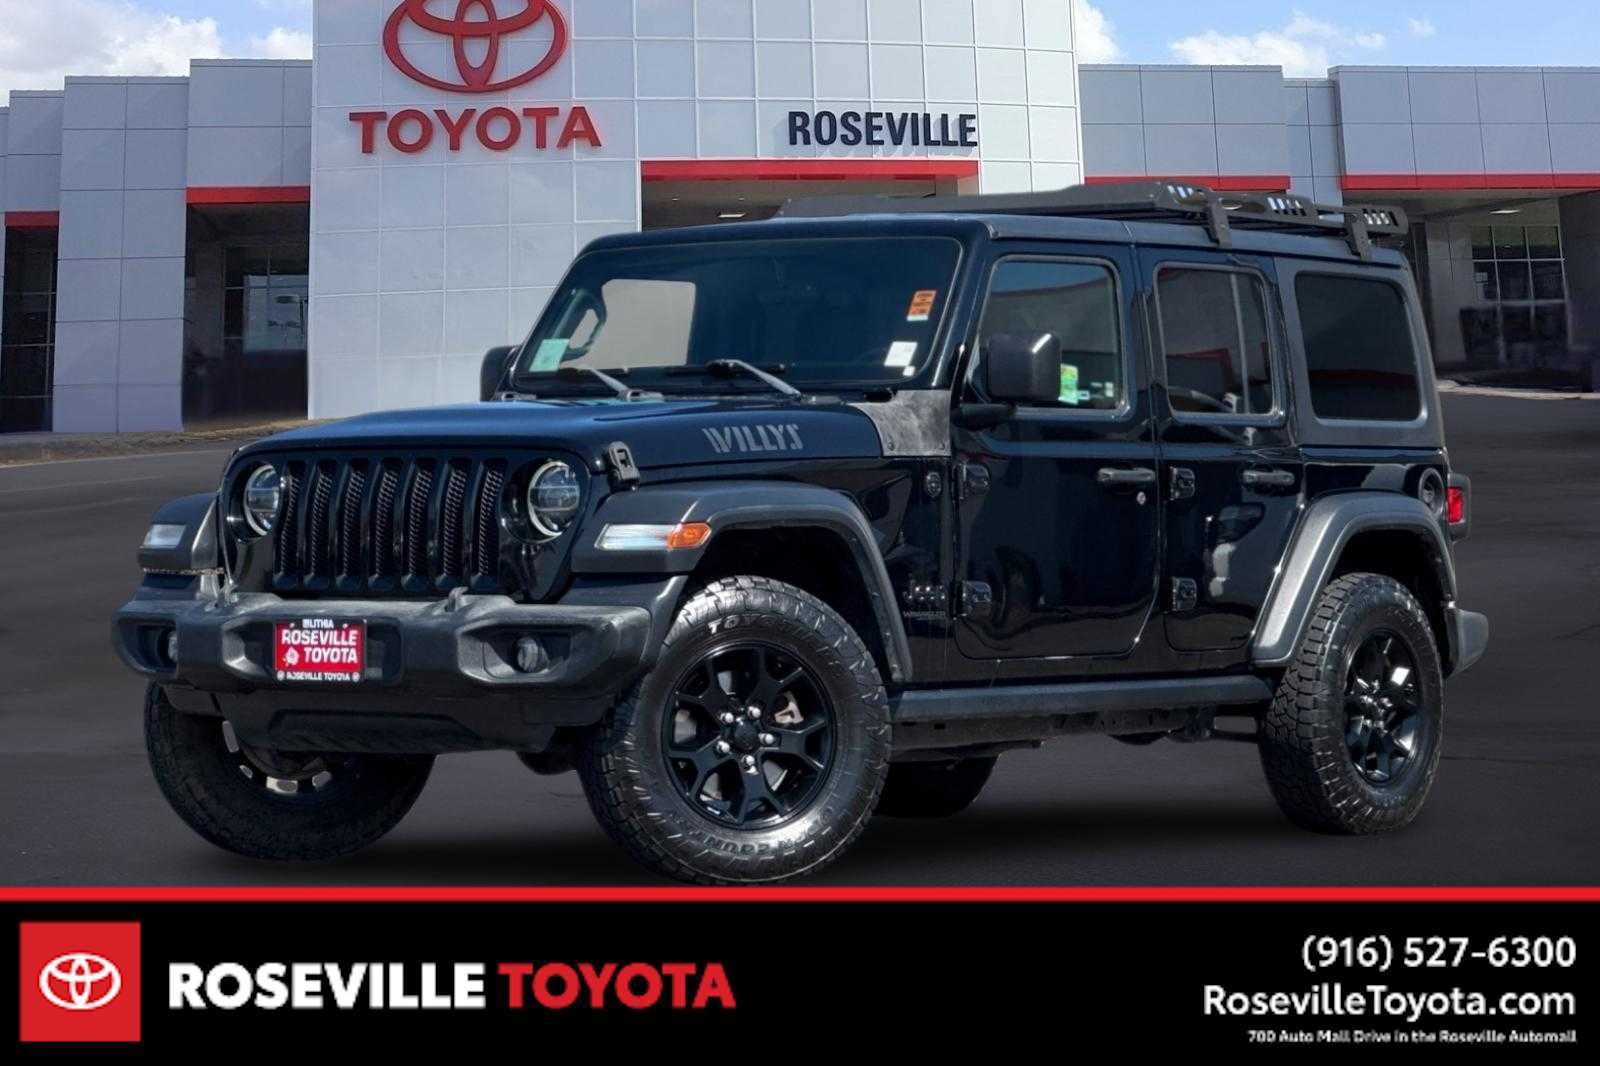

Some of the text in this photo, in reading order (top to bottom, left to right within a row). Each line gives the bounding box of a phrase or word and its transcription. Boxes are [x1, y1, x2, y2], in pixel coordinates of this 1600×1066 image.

[349, 106, 603, 154] TOYOTA
[788, 110, 978, 147] ROSEVILLE
[702, 424, 804, 454] WILLYS
[281, 629, 359, 646] ROSEVILLE
[304, 647, 359, 664] TOYOTA
[286, 671, 351, 681] ROSEVILLE TOYOTA
